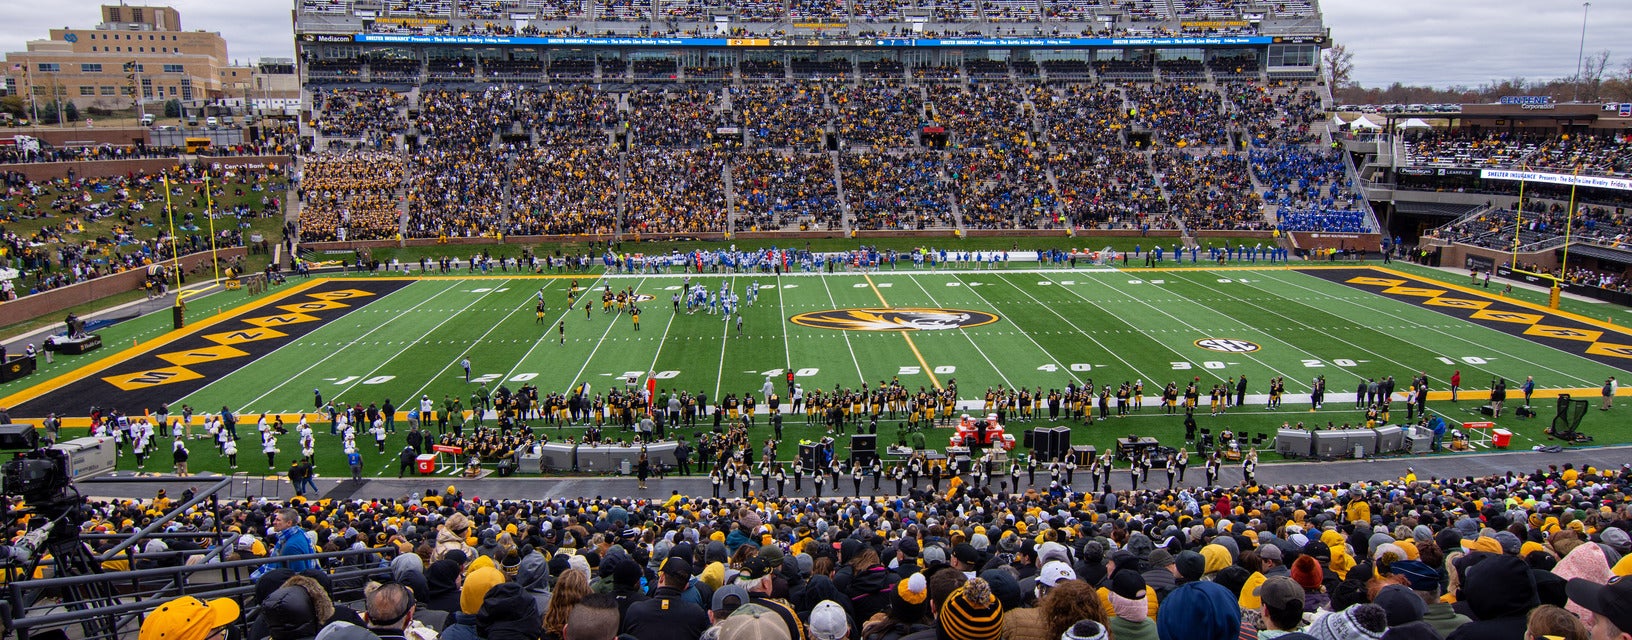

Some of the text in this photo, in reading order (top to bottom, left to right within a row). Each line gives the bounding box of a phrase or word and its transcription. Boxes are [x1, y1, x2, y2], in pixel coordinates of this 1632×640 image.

[1500, 96, 1549, 105] CENTENE
[1521, 103, 1555, 111] Corporation
[1592, 179, 1609, 187] Rivalry
[124, 291, 356, 385] MIZZOU
[1198, 339, 1257, 352] SEC
[1170, 360, 1226, 370] 30
[1300, 359, 1358, 368] 20
[1434, 356, 1488, 365] 10
[760, 367, 820, 377] 40
[897, 365, 957, 375] 50
[1036, 363, 1092, 372] 40
[333, 375, 397, 384] 10
[469, 372, 540, 383] 20
[787, 373, 793, 381] 2
[419, 462, 428, 470] G
